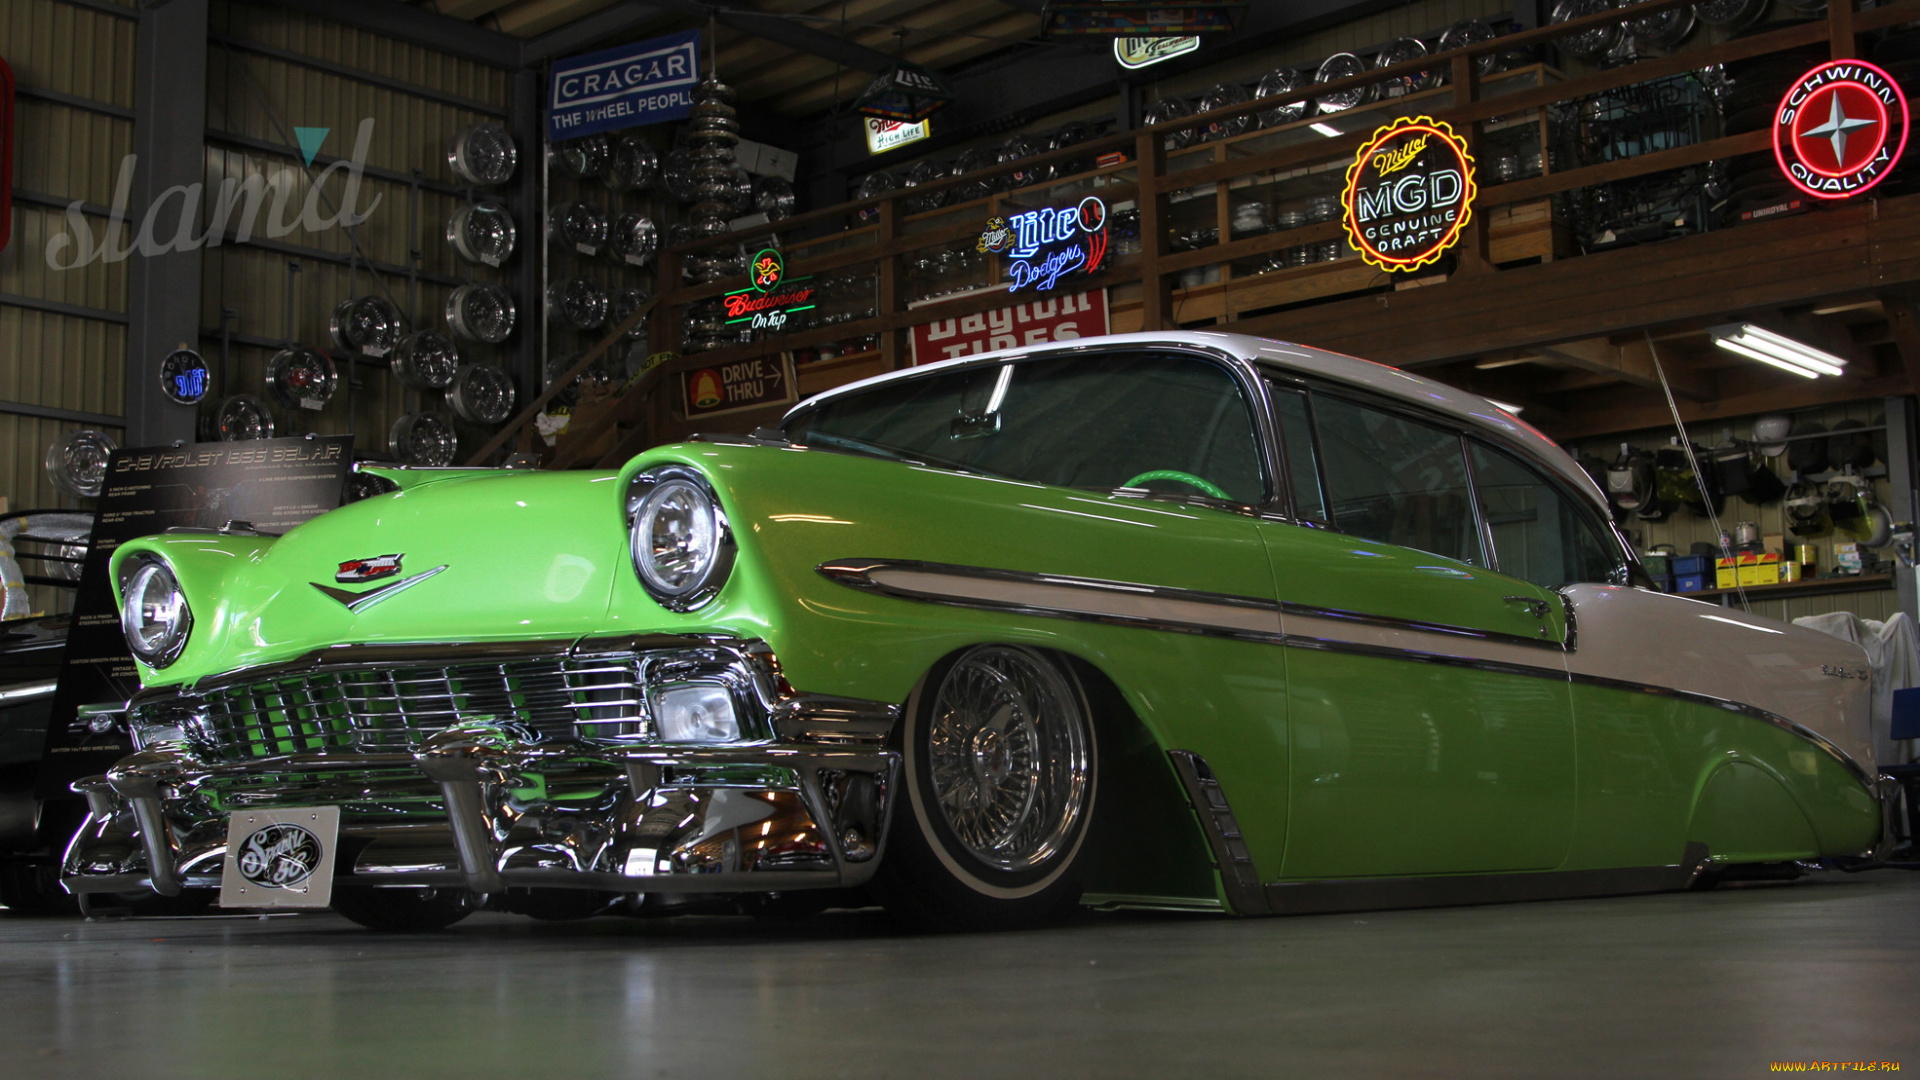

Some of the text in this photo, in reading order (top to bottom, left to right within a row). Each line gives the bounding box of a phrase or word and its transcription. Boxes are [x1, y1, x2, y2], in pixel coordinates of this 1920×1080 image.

[561, 54, 687, 98] CRAGAR
[1780, 66, 1897, 126] SCHWINN
[552, 111, 582, 129] THE
[585, 101, 635, 123] WHEEL
[1373, 132, 1433, 177] Miller
[1791, 146, 1890, 191] QUALITY
[1357, 169, 1463, 222] MGD
[1365, 209, 1456, 239] GENUINE
[1753, 204, 1788, 218] UNIROYAL
[982, 227, 1009, 248] Miller
[1008, 207, 1079, 258] Lite
[1378, 227, 1443, 252] DRAFT
[1009, 243, 1086, 293] Dodgers
[723, 289, 815, 317] Budweiser
[751, 310, 787, 330] On Tap
[721, 360, 764, 384] DRIVE
[726, 380, 764, 402] THRU
